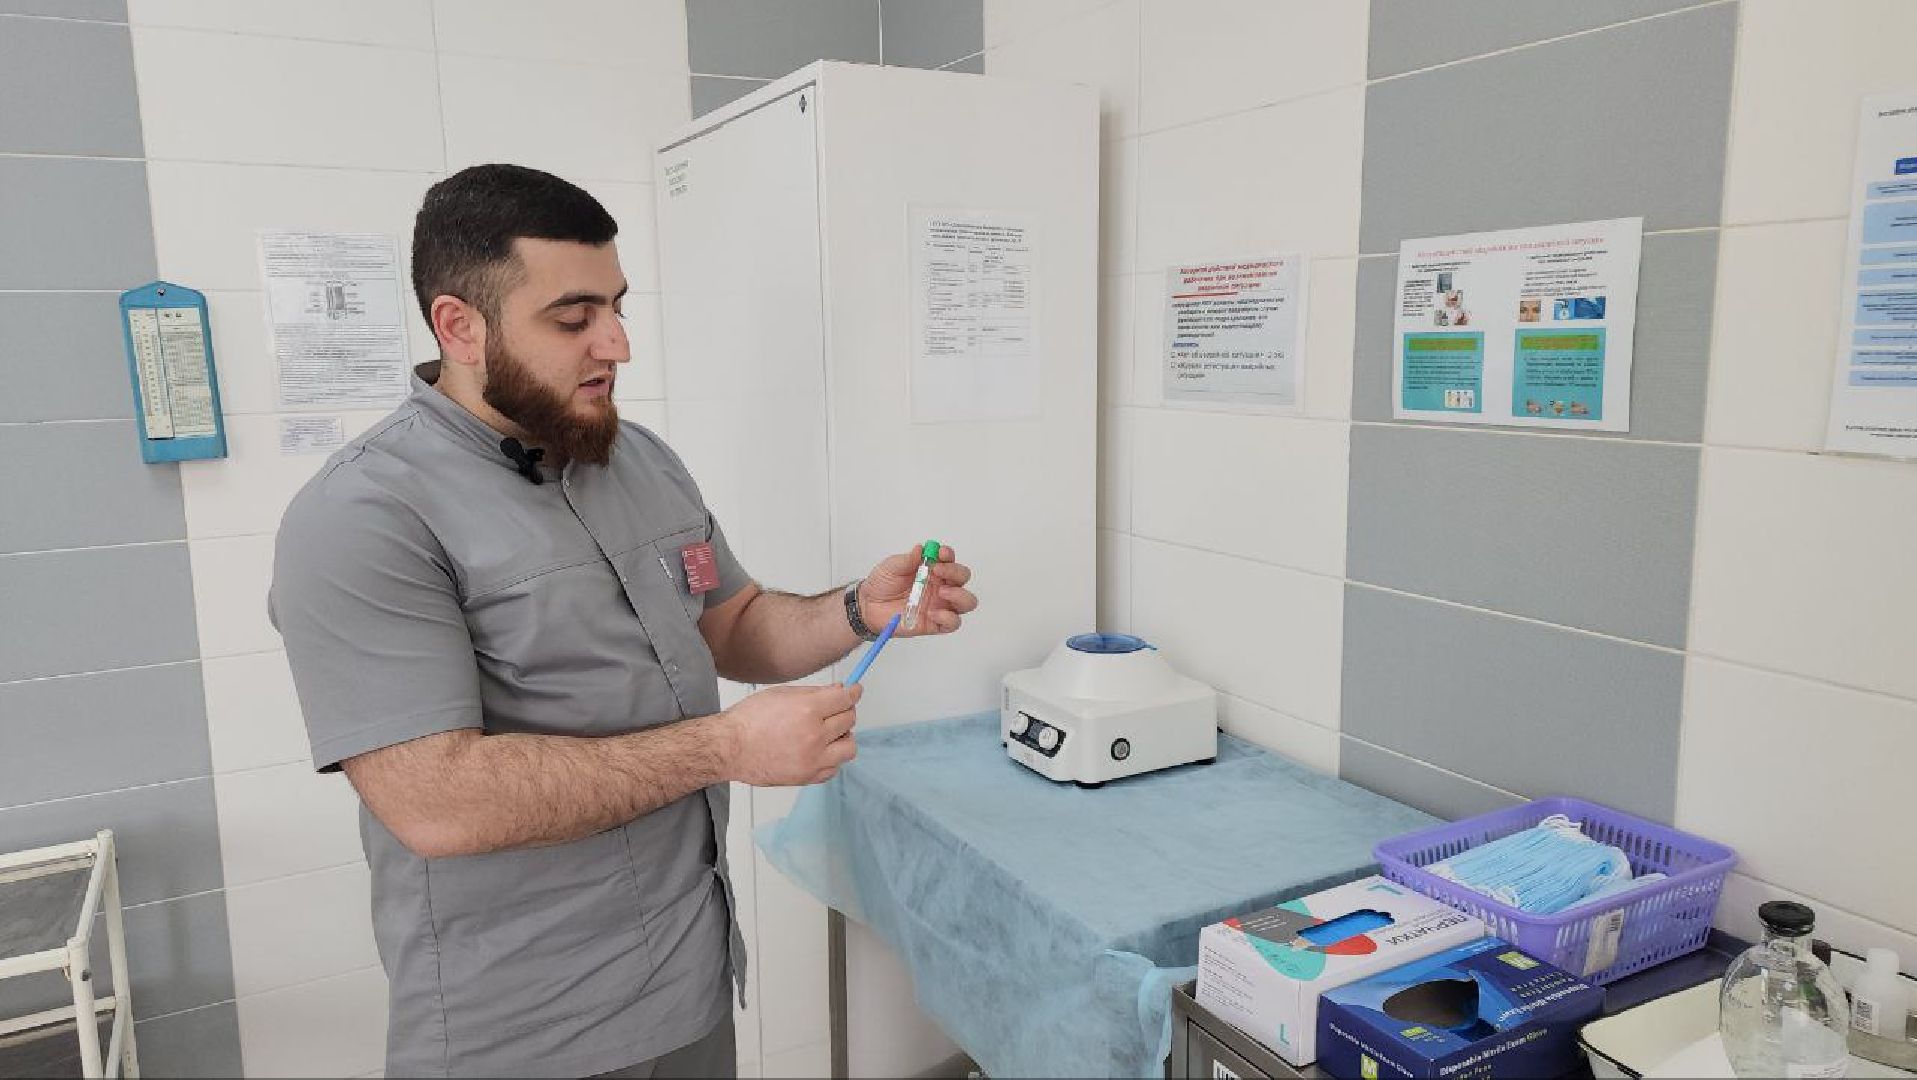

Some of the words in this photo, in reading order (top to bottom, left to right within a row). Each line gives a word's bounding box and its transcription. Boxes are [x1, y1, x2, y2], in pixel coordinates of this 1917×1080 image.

[1386, 914, 1467, 946] ПЕРЧАТКИ
[1279, 1023, 1291, 1046] L
[1439, 1055, 1482, 1077] Disposable
[1482, 1044, 1505, 1058] Nitrile
[1506, 1036, 1526, 1050] Exam
